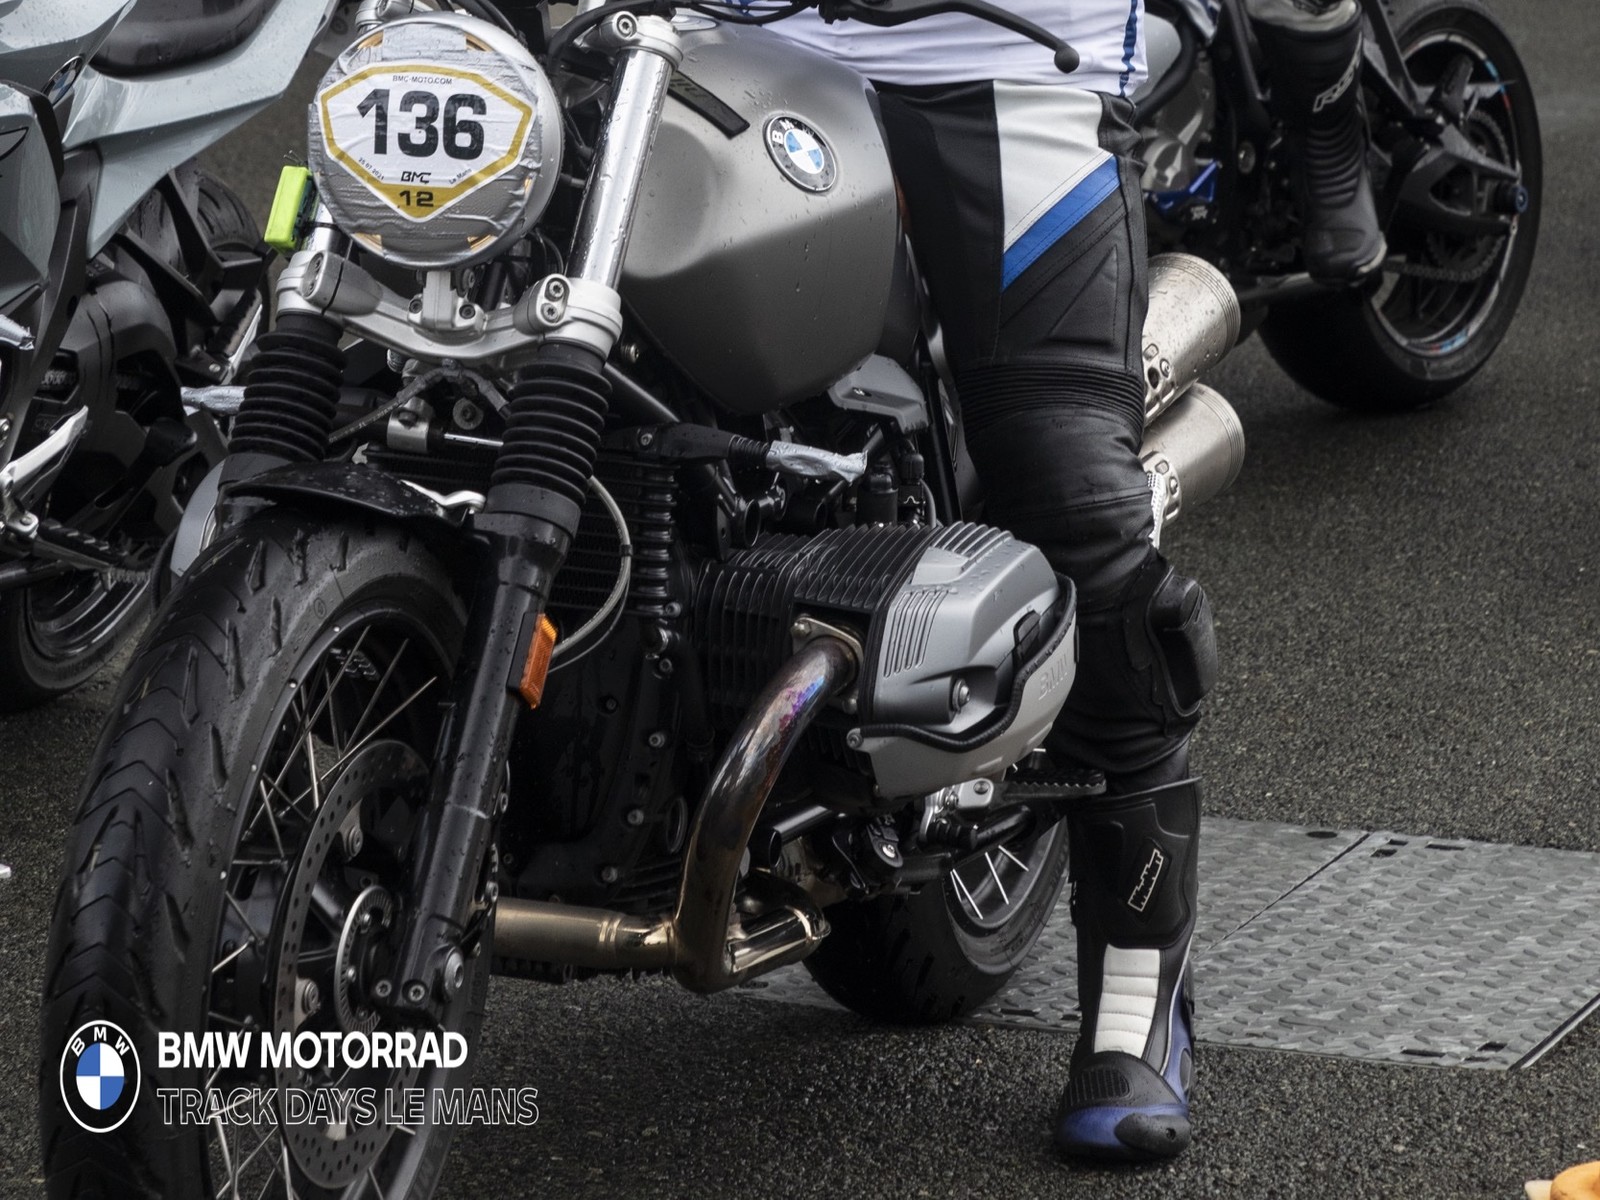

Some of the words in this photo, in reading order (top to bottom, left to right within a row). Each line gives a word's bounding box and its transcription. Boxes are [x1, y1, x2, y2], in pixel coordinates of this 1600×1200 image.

[357, 88, 487, 160] 136
[771, 119, 814, 145] BMW
[401, 171, 431, 184] BMC
[398, 190, 434, 208] 12
